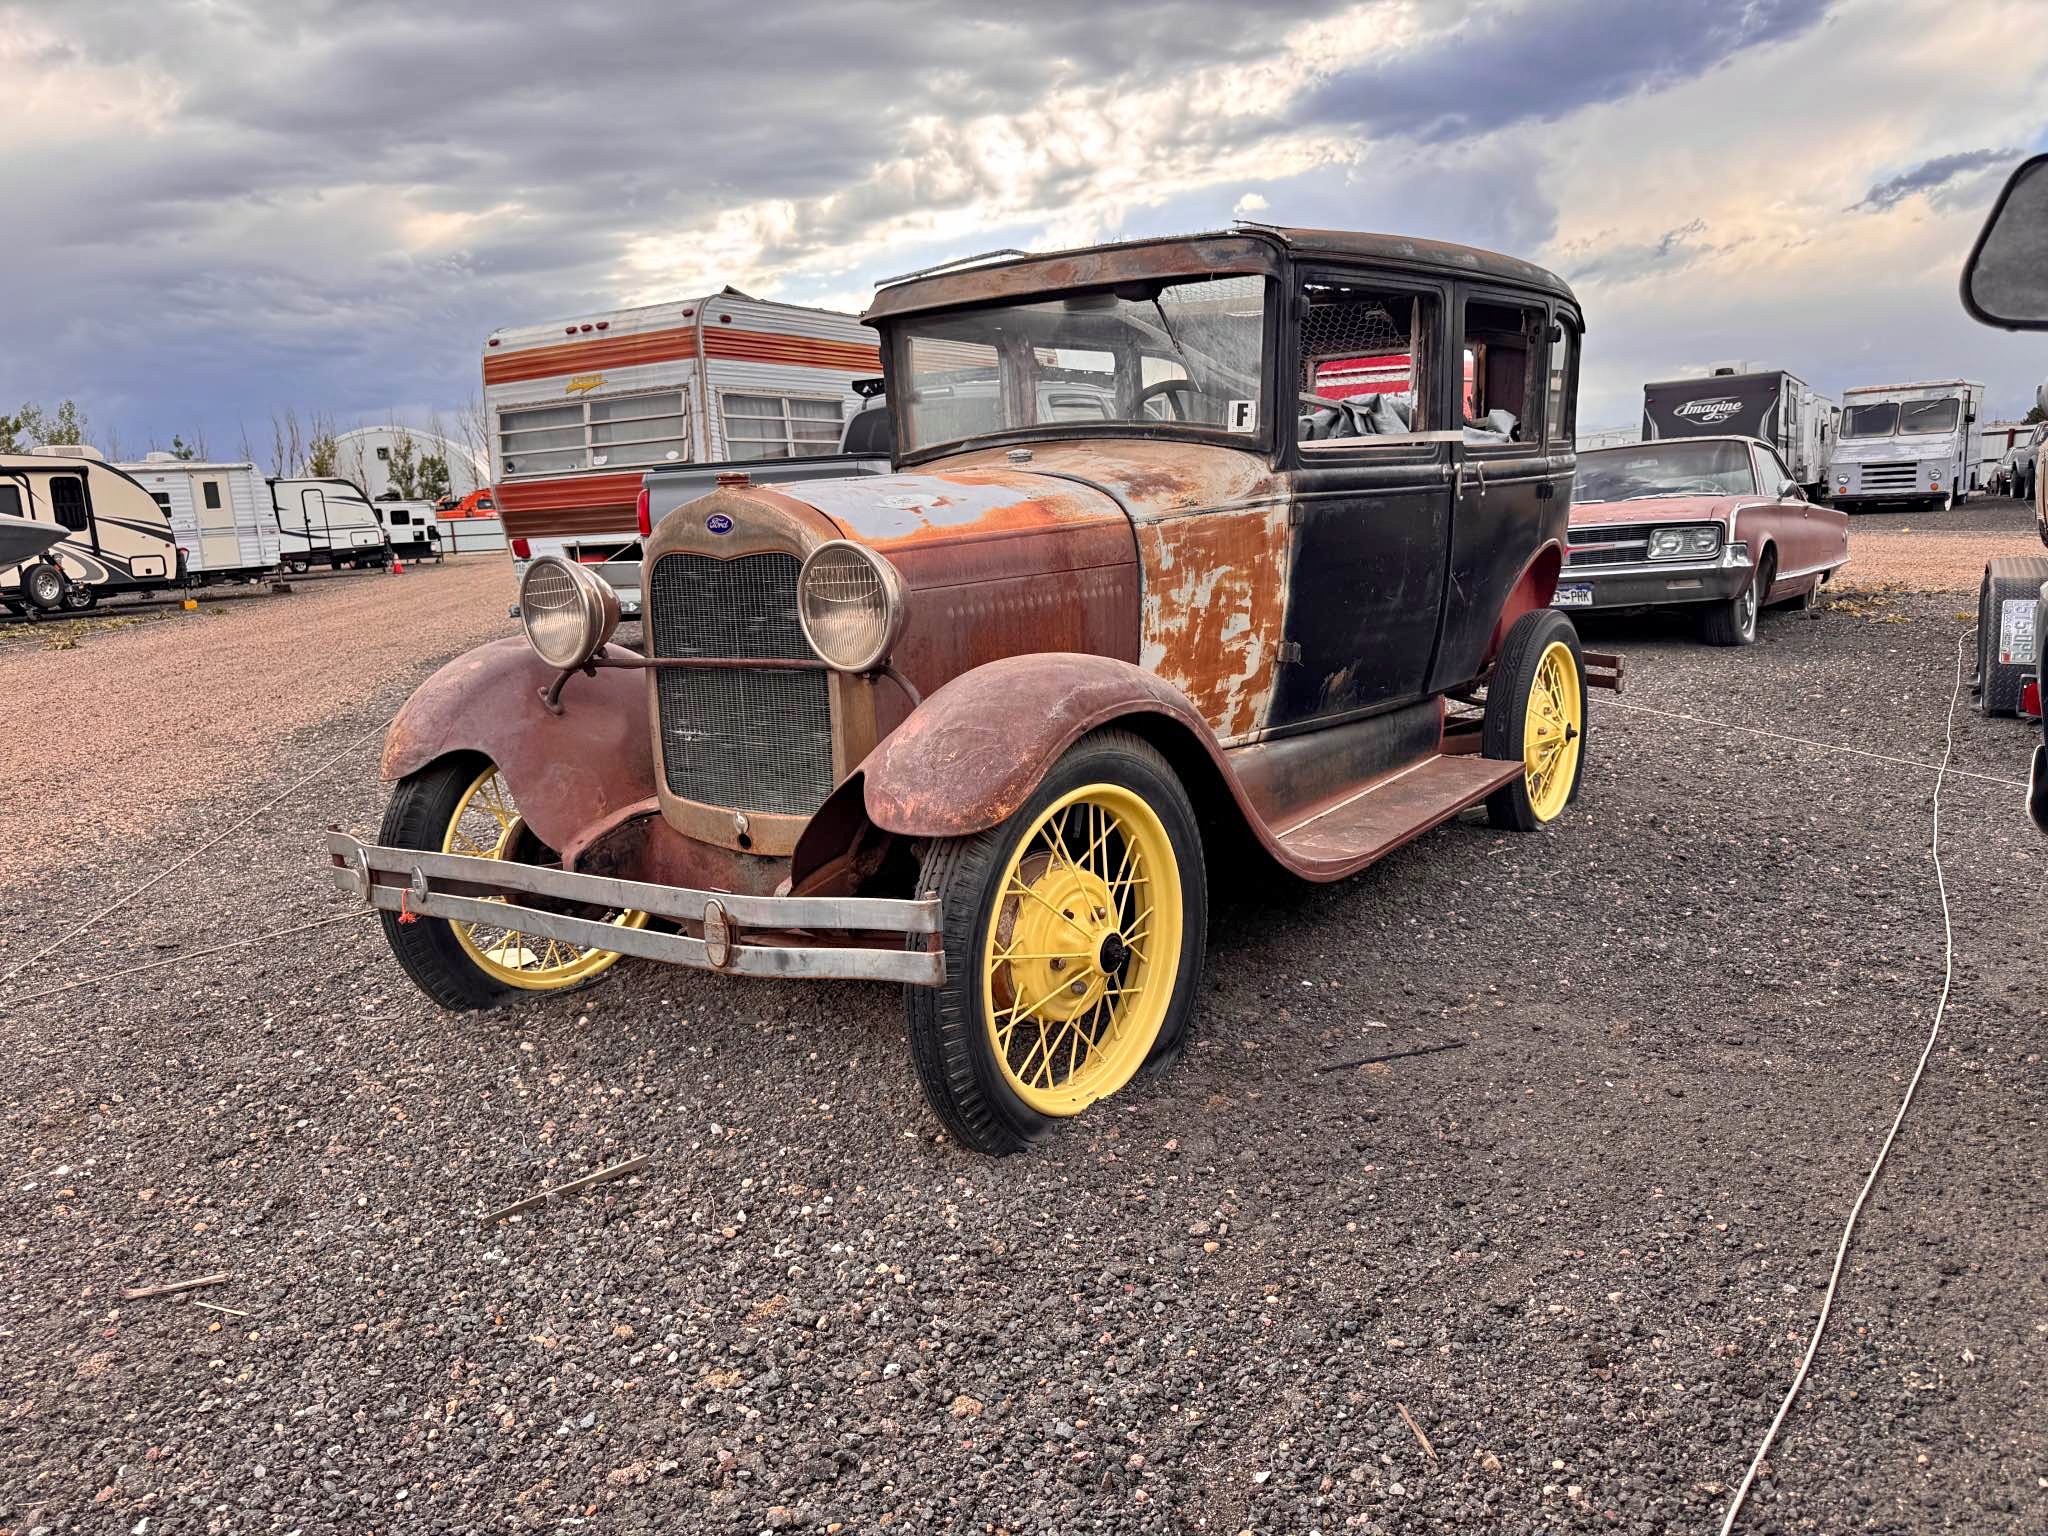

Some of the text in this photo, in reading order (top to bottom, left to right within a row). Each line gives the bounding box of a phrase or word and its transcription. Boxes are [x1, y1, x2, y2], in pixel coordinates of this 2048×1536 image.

[1236, 403, 1249, 427] F
[1680, 400, 1743, 420] Imagine
[709, 517, 729, 529] Ford
